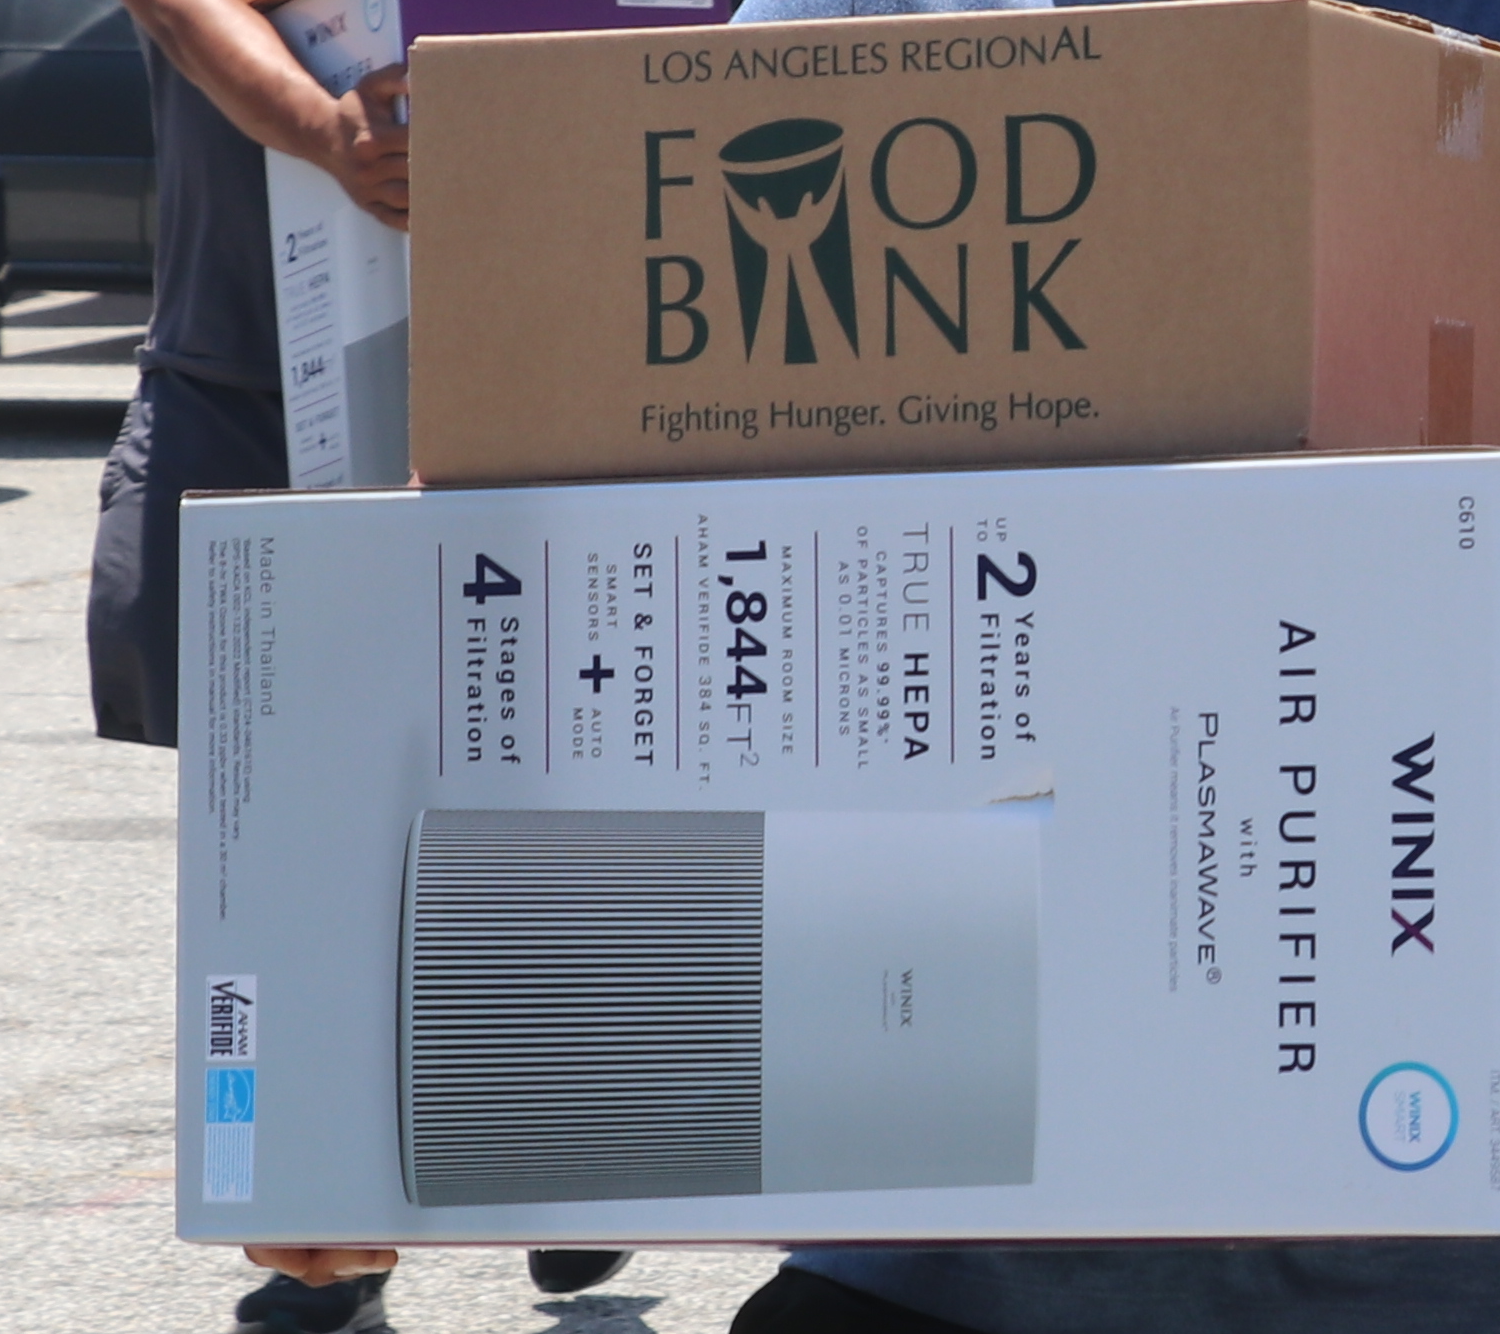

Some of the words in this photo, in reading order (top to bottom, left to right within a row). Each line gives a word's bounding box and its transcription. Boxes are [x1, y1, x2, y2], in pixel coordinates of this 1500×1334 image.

[642, 48, 717, 85] LOS
[724, 39, 888, 81] ANGELES
[900, 24, 1102, 74] REGIONAL
[641, 401, 759, 440] Fighting
[768, 397, 886, 435] Hunger.
[898, 393, 997, 433] Giving
[1007, 389, 1100, 427] Hope.
[696, 514, 708, 568] AHAM
[855, 526, 868, 549] OF
[975, 519, 987, 543] TO
[994, 517, 1006, 543] UP
[1457, 495, 1474, 550] C610
[259, 537, 274, 593] Made
[462, 553, 521, 605] 4
[632, 543, 652, 598] SET
[780, 546, 792, 639] MAXIMUM
[837, 561, 849, 585] AS
[901, 523, 928, 633] TRUE
[975, 550, 1036, 601] 2
[259, 601, 274, 619] in
[586, 553, 599, 642] SENSORS
[605, 564, 617, 629] SMART
[633, 613, 652, 631] &
[697, 578, 709, 666] VERIFIDE
[837, 594, 851, 638] 0.01
[856, 559, 868, 664] PARTICLES
[874, 551, 887, 653] CAPTURES
[259, 627, 275, 717] Thailand
[495, 617, 518, 720] Stages
[780, 649, 792, 703] ROOM
[1013, 612, 1033, 698] Years
[1277, 620, 1316, 726] AIR
[465, 618, 486, 763] Filtration
[633, 646, 653, 767] FORGET
[697, 676, 711, 712] 384
[837, 648, 850, 737] MICRONS
[856, 674, 868, 698] AS
[902, 652, 929, 761] HEPA
[978, 613, 1000, 761] Filtration
[499, 735, 520, 765] of
[571, 708, 583, 761] MODE
[589, 708, 601, 759] AUTO
[780, 712, 792, 755] SIZE
[856, 707, 869, 770] SMALL
[1014, 713, 1035, 743] of
[1166, 725, 1180, 767] Purifier
[1166, 771, 1180, 812] means
[1166, 825, 1180, 876] removes
[1238, 818, 1257, 879] with
[1390, 733, 1434, 957] WINIX
[1166, 879, 1180, 939] inanimate
[1277, 765, 1316, 1074] PURIFIER
[209, 981, 253, 1057] VERIFIDE
[236, 1010, 248, 1056] AHAM
[1407, 1090, 1420, 1144] WINIX
